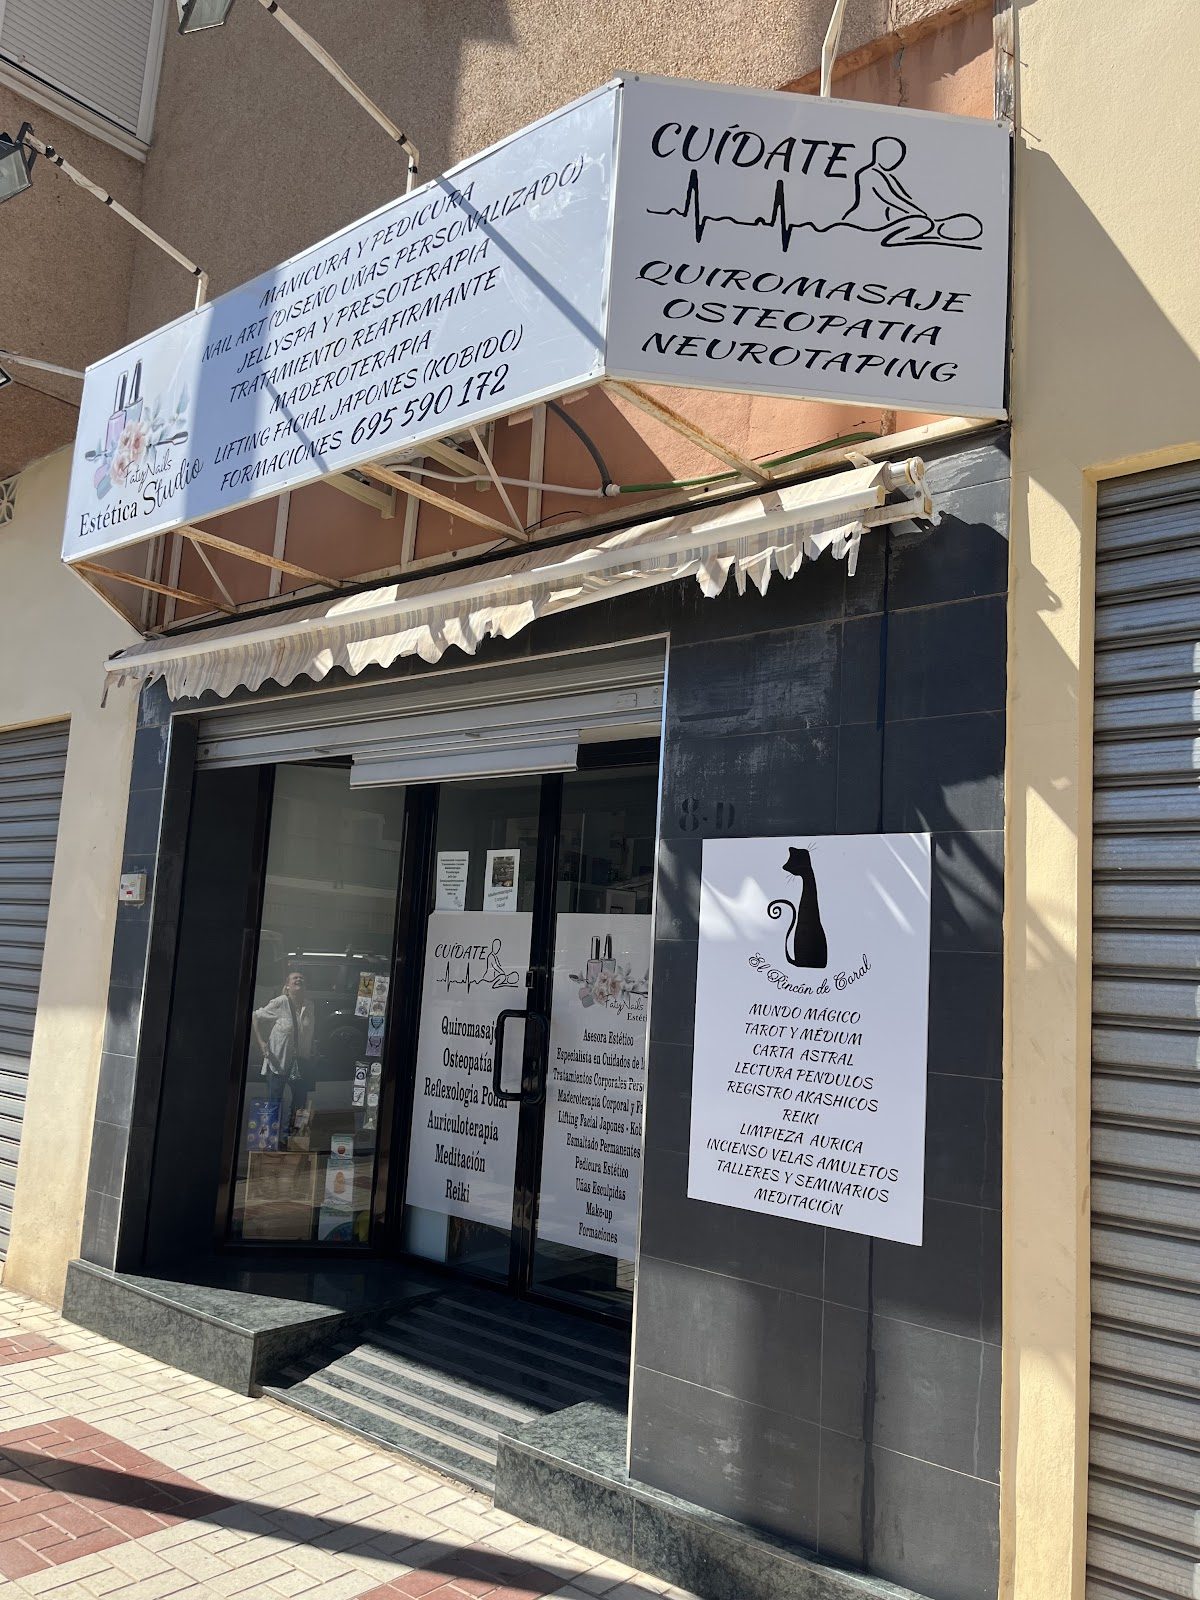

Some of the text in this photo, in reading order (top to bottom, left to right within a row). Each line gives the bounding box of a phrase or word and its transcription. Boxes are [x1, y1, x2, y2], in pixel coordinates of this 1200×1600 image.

[651, 121, 856, 179] CUÍDATE
[202, 155, 584, 362] NAIL ART (DISEÑO UÑAS PERSONALIZADO)
[259, 181, 475, 309] MANICURA Y PEDICURA
[635, 260, 972, 314] QUIROMASAJE
[237, 237, 490, 374] JELLYSPA Y PRESOTERAPIA
[230, 265, 500, 403] TRATAMIENTO REAFIRMANTE
[662, 298, 942, 345] OSTEOPATIA
[641, 331, 958, 382] NEUROTAPING
[269, 329, 432, 414] MADEROTERAPIA
[214, 323, 523, 464] LIFTING FACIAL JAPONES (KOBIDO)
[220, 363, 509, 491] FORMACIONES 695 590 172
[79, 458, 203, 538] Estética Studio
[434, 942, 489, 960] CUÍDATE
[748, 952, 771, 972] El
[767, 969, 813, 994] Rincón
[816, 978, 831, 995] de
[748, 1003, 861, 1024] MUNDO MÁGICO
[441, 1015, 496, 1045] Quiromasaj
[583, 1028, 634, 1046] Asesora Estético
[745, 1022, 863, 1046] TAROT Y MÉDIUM
[443, 1047, 492, 1075] Osteopatía
[556, 1047, 592, 1064] Especialista
[593, 1056, 601, 1065] en
[602, 1052, 631, 1069] Cuidados
[631, 1057, 640, 1070] de
[752, 1043, 854, 1066] CARTA ASTRAL
[553, 1067, 644, 1092] Tratamientos Corporales Pers
[734, 1061, 874, 1090] LECTURA PENDULOS
[557, 1089, 601, 1111] Maderoterapia
[602, 1095, 629, 1113] Corporal
[630, 1102, 635, 1116] y
[727, 1080, 879, 1113] REGISTRO AKASHICOS
[427, 1109, 499, 1144] Auriculoterapia
[558, 1110, 579, 1128] Lifting
[580, 1113, 598, 1128] Facial
[599, 1116, 625, 1134] Japones
[782, 1108, 819, 1125] REIKI
[566, 1132, 641, 1159] Esmaltado Permanentes
[740, 1123, 864, 1154] LIMPIEZA AURICA
[434, 1143, 486, 1172] Meditación
[575, 1156, 629, 1179] Pedicura Estético
[706, 1137, 899, 1182] INCIENSO VELAS AMULETOS
[445, 1178, 470, 1203] Reiki
[575, 1177, 626, 1201] Uñas Esculpidas
[717, 1159, 890, 1203] TALLERES Y SEMINARIOS
[585, 1201, 613, 1223] Make-up
[753, 1187, 844, 1216] MEDITACIÓN
[578, 1222, 618, 1244] Formaciones
